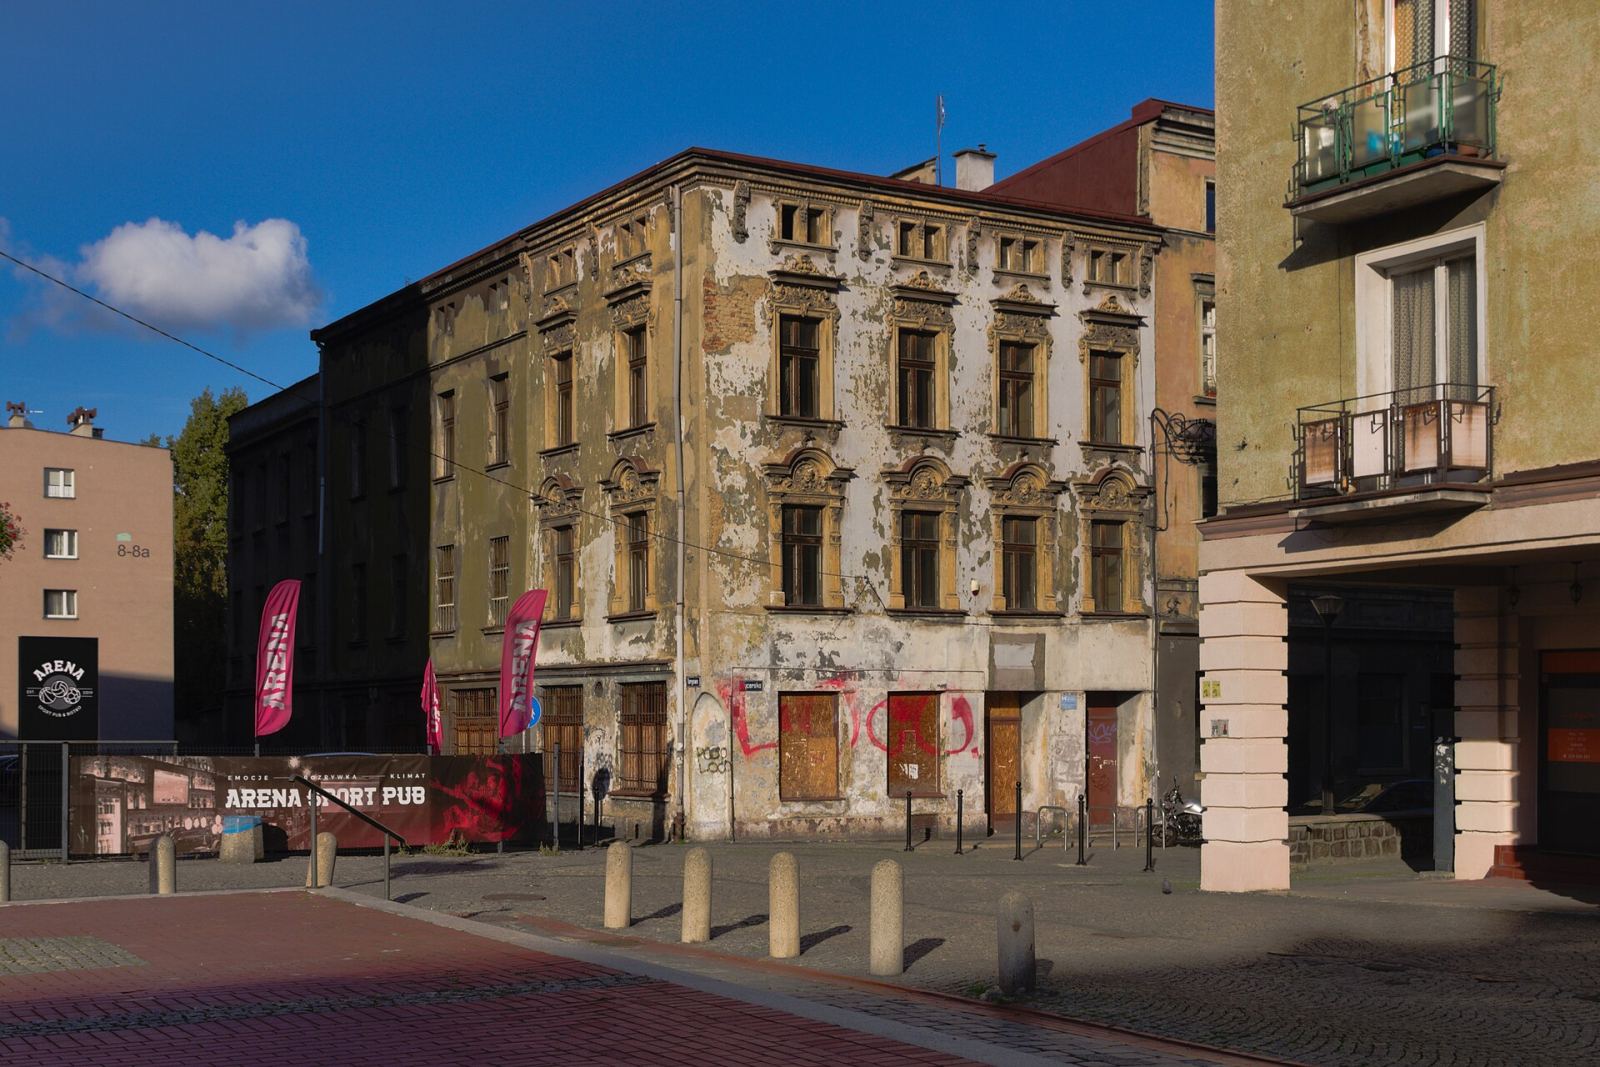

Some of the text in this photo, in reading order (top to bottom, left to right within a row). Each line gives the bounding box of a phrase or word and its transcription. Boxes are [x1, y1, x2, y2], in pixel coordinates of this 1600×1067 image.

[117, 544, 150, 558] 8-8a
[33, 660, 85, 682] ARENA
[261, 612, 289, 711] ARENA
[510, 619, 537, 712] ARENA
[225, 788, 302, 809] ARENA
[382, 786, 426, 806] PUB
